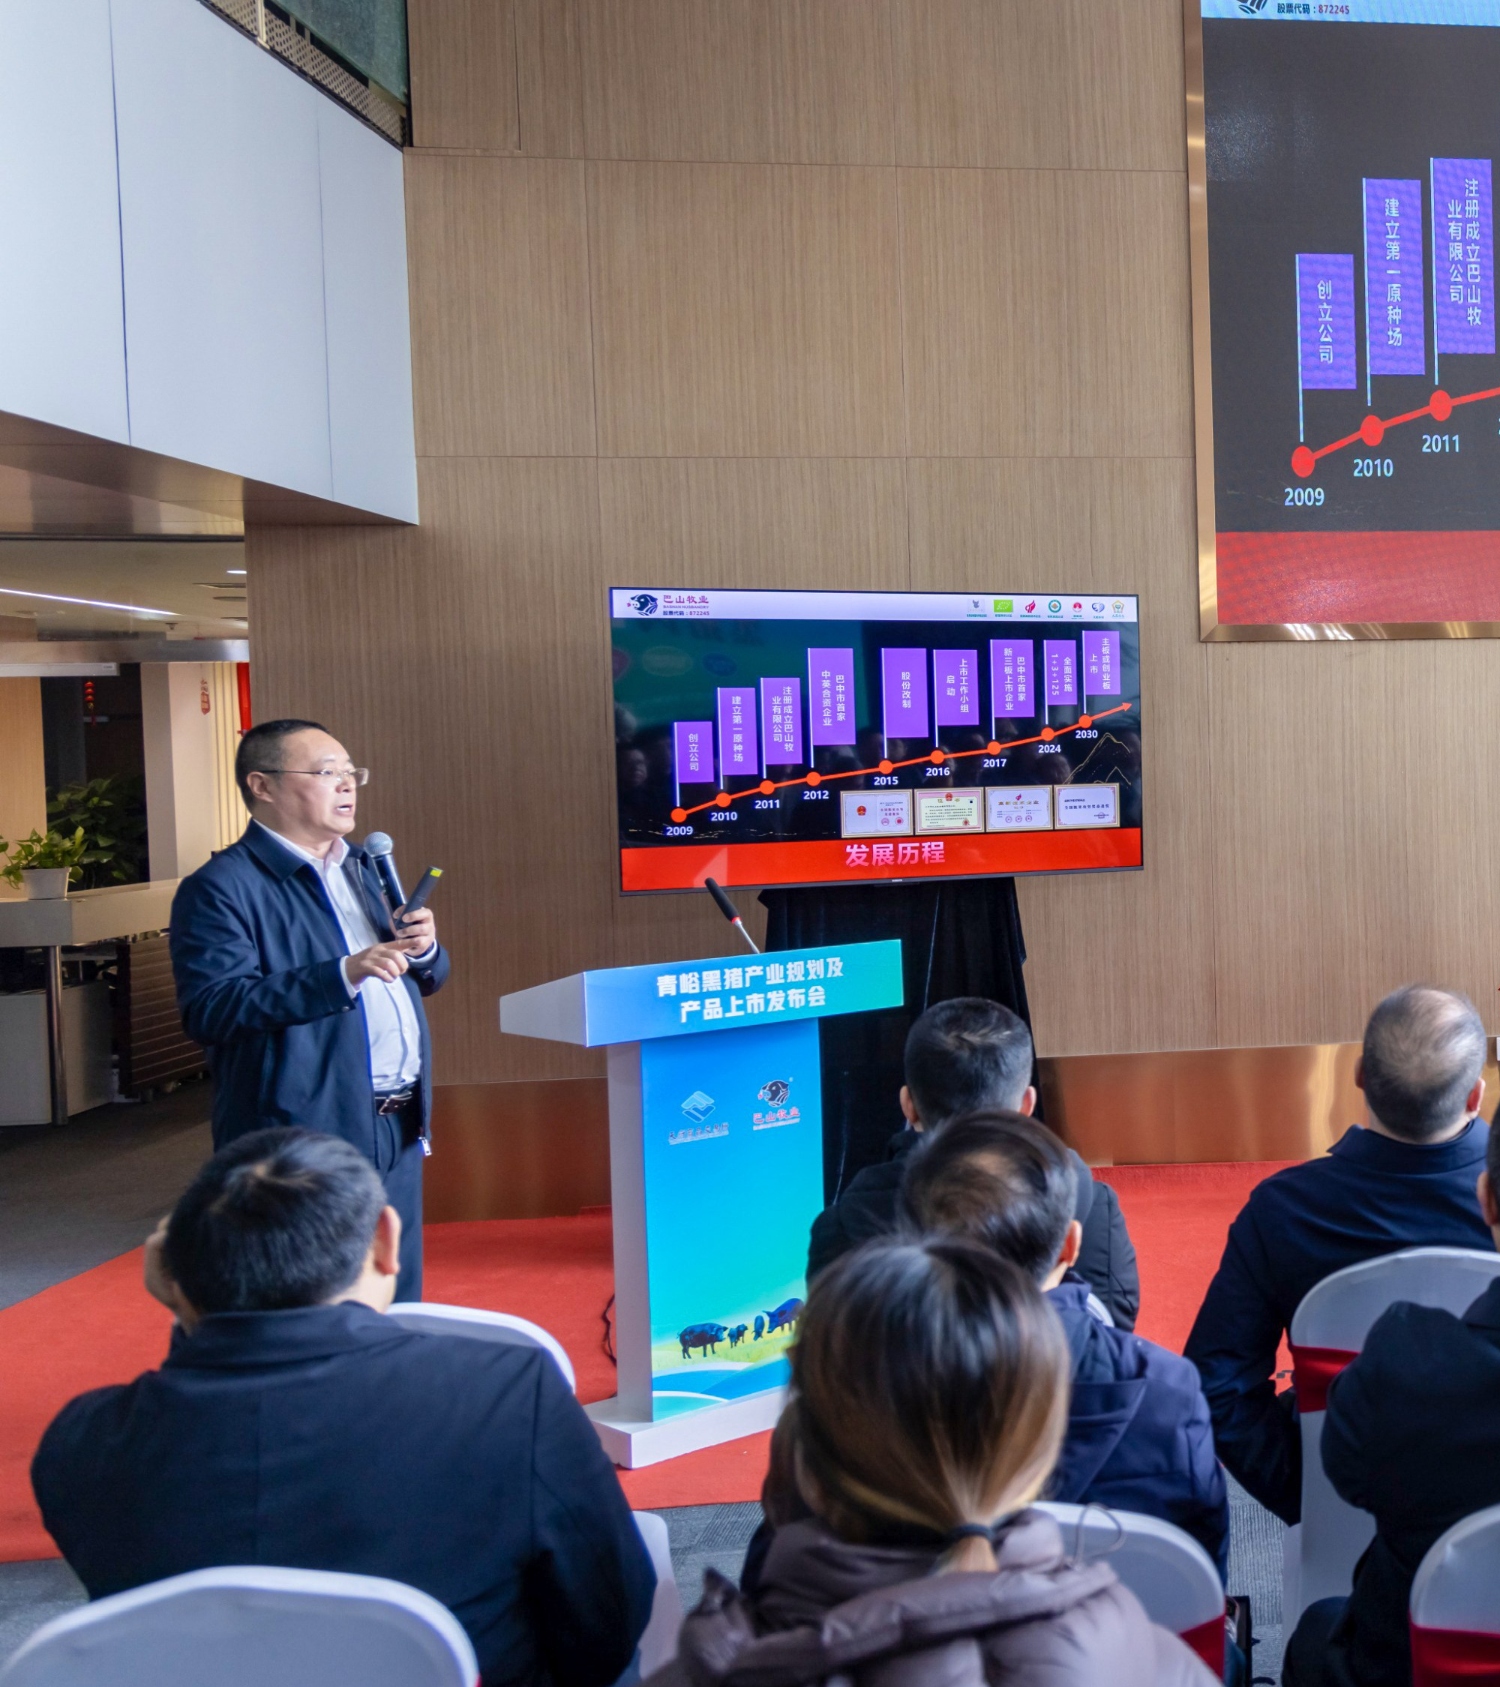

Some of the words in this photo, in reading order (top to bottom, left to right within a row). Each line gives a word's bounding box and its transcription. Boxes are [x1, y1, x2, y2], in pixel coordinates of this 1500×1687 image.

[1447, 199, 1464, 305] 业有限公司
[1464, 178, 1482, 327] 注册成立巴山牧
[1384, 197, 1403, 347] 建立第一原种场
[1317, 279, 1334, 365] 创立公司
[1421, 434, 1460, 453] 2011
[1353, 458, 1394, 478] 2010
[1284, 487, 1325, 507] 2009
[663, 594, 709, 604] 巴山牧业
[1003, 647, 1014, 711] 新三板上市企业
[1016, 656, 1027, 702] 巴中市首家
[1063, 656, 1073, 693] 全面实施
[1089, 653, 1099, 674] 上市
[1101, 637, 1111, 690] 主板或创业板
[821, 669, 833, 727] 中英合资企业
[835, 674, 846, 722] 巴中市首家
[901, 671, 912, 709] 股份改制
[946, 674, 956, 697] 启动
[959, 658, 970, 713] 上市工作小组
[731, 695, 744, 763] 建立第一原种场
[771, 695, 783, 743] 业有限公司
[782, 686, 794, 752] 注册成立巴山牧
[1075, 729, 1099, 739] 2030
[687, 733, 699, 772] 创立公司
[983, 758, 1007, 768] 2017
[1038, 744, 1062, 754] 2024
[873, 776, 899, 786] 2015
[925, 766, 951, 777] 2016
[754, 799, 780, 810] 2011
[803, 789, 830, 800] 2012
[666, 825, 693, 836] 2009
[710, 811, 738, 822] 2010
[845, 840, 946, 868] 发展历程
[656, 957, 844, 998] 青峪黑猪产业规划及
[680, 985, 827, 1023] 产品上市发布会
[753, 1107, 800, 1124] 巴山牧业
